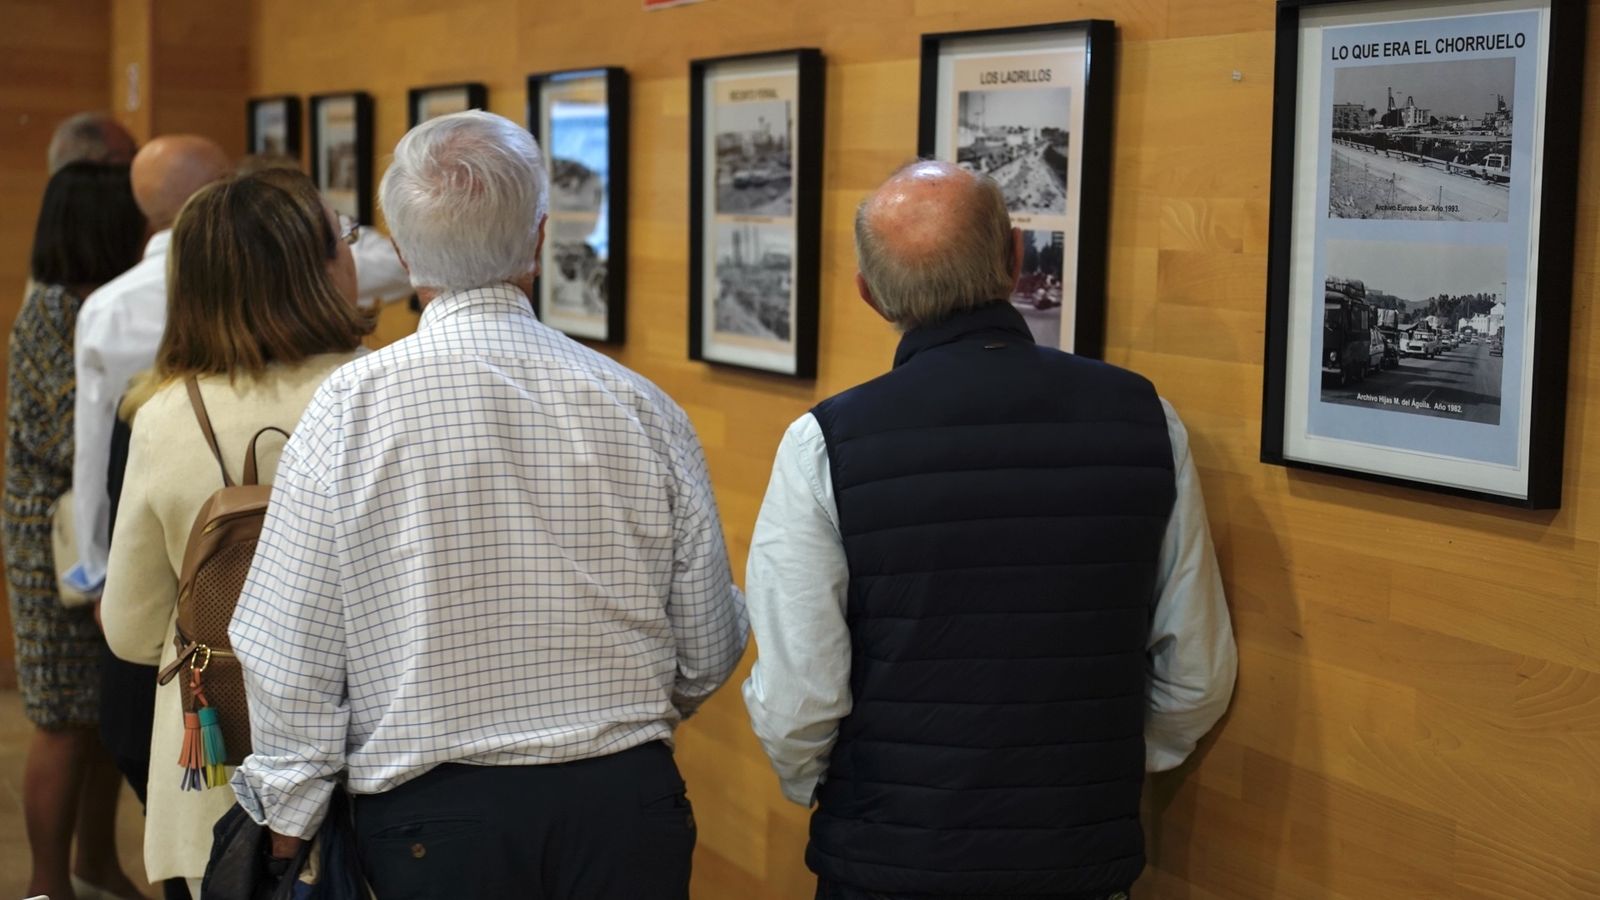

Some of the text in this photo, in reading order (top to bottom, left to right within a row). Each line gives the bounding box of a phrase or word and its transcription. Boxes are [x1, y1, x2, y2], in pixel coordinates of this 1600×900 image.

[1331, 32, 1526, 61] LO QUE ERA EL CHORRUELO
[979, 69, 1052, 85] LOS LADRILLOS
[1397, 204, 1418, 213] Europa
[1357, 393, 1378, 402] Archivo
[1434, 403, 1447, 411] Año
